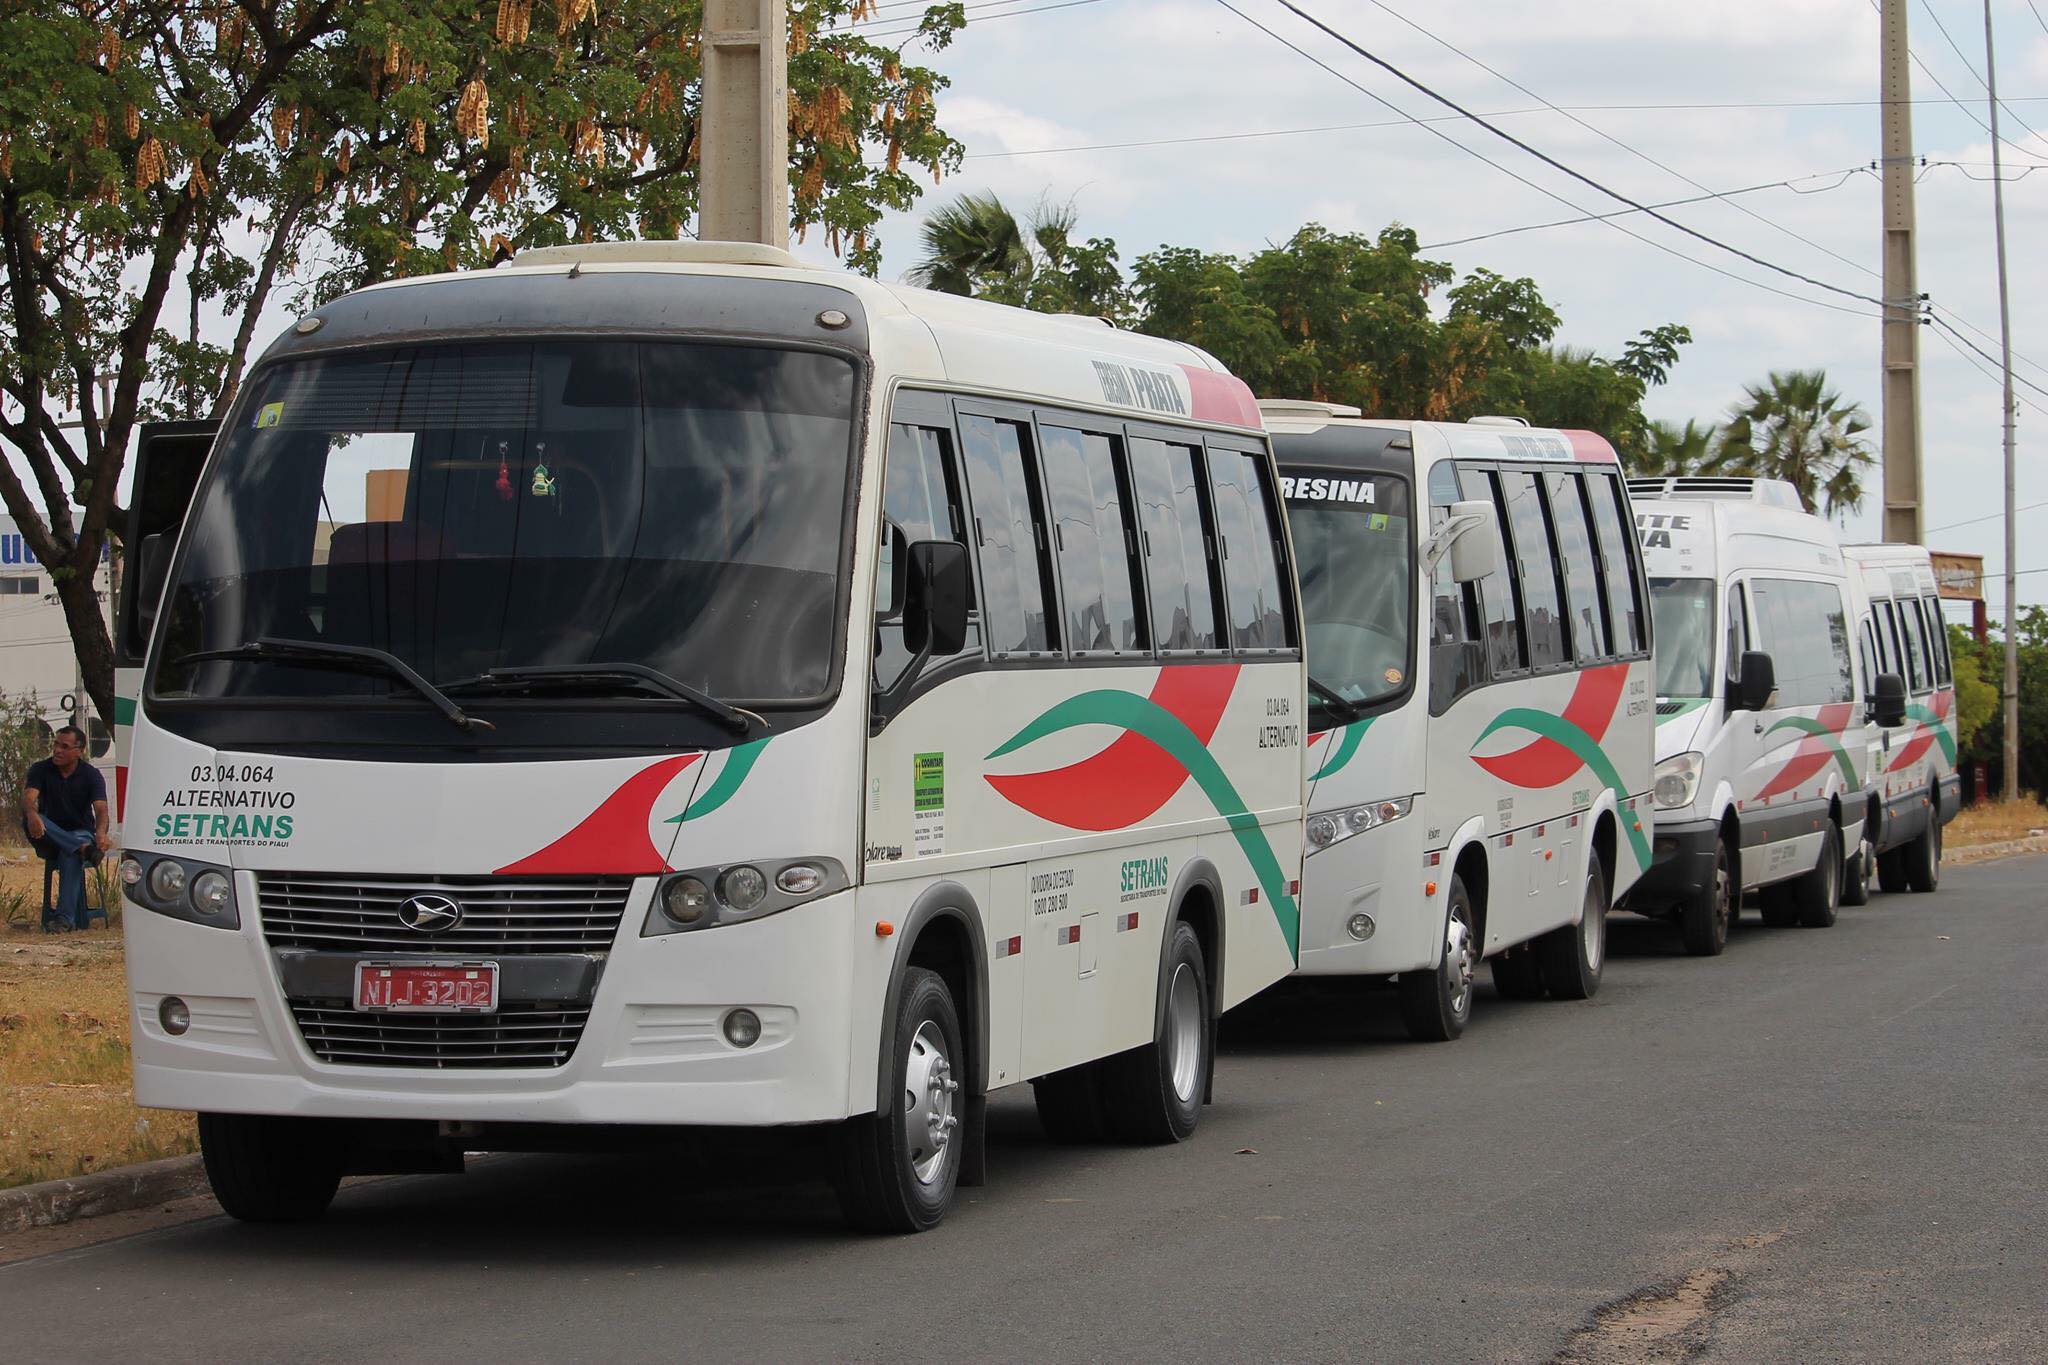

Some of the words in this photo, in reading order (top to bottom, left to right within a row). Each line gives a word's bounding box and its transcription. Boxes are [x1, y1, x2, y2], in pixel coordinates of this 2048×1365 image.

[1128, 367, 1186, 415] PRATA
[1259, 725, 1299, 748] ALTERNATIVO
[191, 765, 274, 783] 03.04.064
[163, 790, 295, 809] ALTERNATIVO
[154, 813, 294, 839] SETRANS
[153, 838, 194, 846] SECRETARIA
[206, 839, 255, 847] TRANSPORTES
[257, 839, 268, 847] DO
[866, 842, 886, 862] olare
[1120, 856, 1169, 892] SETRANS
